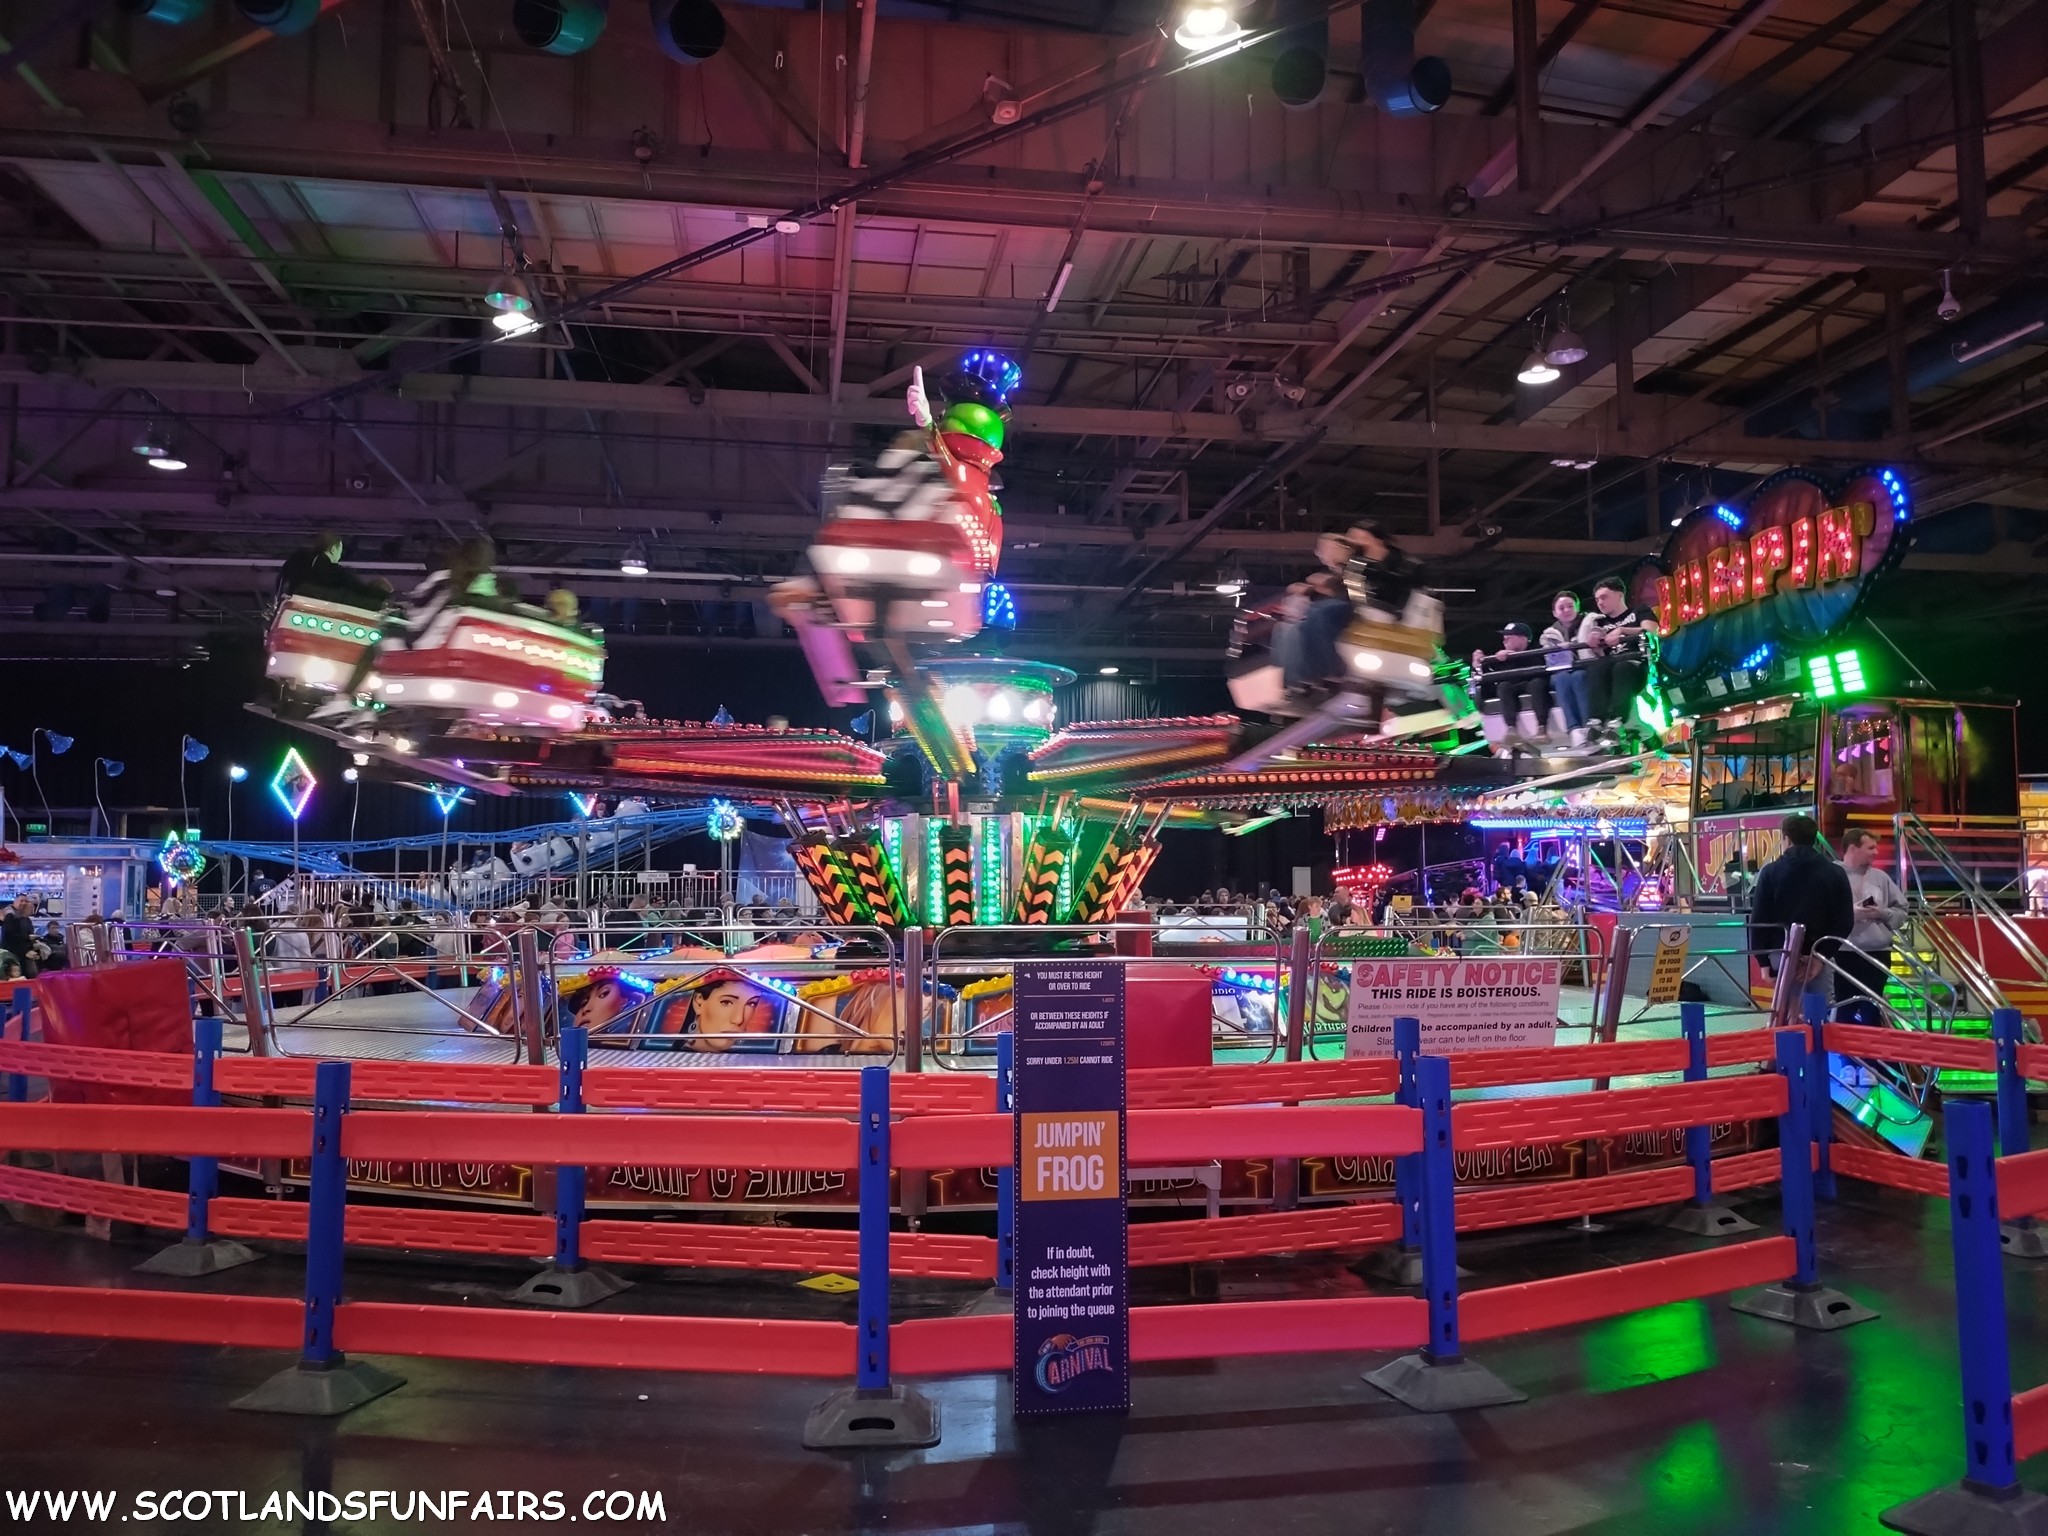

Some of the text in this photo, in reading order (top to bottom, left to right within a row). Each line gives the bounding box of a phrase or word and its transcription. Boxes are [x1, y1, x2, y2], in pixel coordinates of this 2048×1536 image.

[1037, 971, 1103, 979] YOU MUST BE THIS HEIGHT
[1356, 962, 1558, 988] SAFETY NOTICE
[1057, 982, 1071, 990] OVER
[1071, 982, 1078, 990] TO
[1079, 982, 1091, 990] RIDE
[1212, 988, 1236, 996] UDIO
[1371, 987, 1541, 999] THIS RIDE IS BOISTEROUS.
[1030, 1011, 1109, 1020] OR BETWEEN THESE HEIGHTS IF
[1034, 1021, 1105, 1030] ACCOMPANIED BY AN ADULT
[1352, 1025, 1391, 1033] Children
[1435, 1022, 1498, 1032] accompanied
[1501, 1021, 1512, 1031] by
[1528, 1020, 1553, 1029] adult.
[1376, 1037, 1395, 1045] Slac
[1468, 1034, 1480, 1042] left
[1495, 1034, 1507, 1042] the
[1509, 1033, 1526, 1042] floor
[1026, 1057, 1044, 1065] SORRY
[1044, 1057, 1062, 1065] UNDER
[1080, 1056, 1101, 1064] CANNOT
[1101, 1055, 1113, 1064] RIDE
[1034, 1121, 1105, 1148] JUMPIN'
[1037, 1154, 1104, 1192] FROG
[1047, 1245, 1095, 1260] If in doubt,
[1031, 1264, 1111, 1280] check height with
[1028, 1283, 1113, 1299] the attendant prior
[1027, 1303, 1115, 1320] to joining the queue
[1036, 1346, 1113, 1392] CARNIVAL
